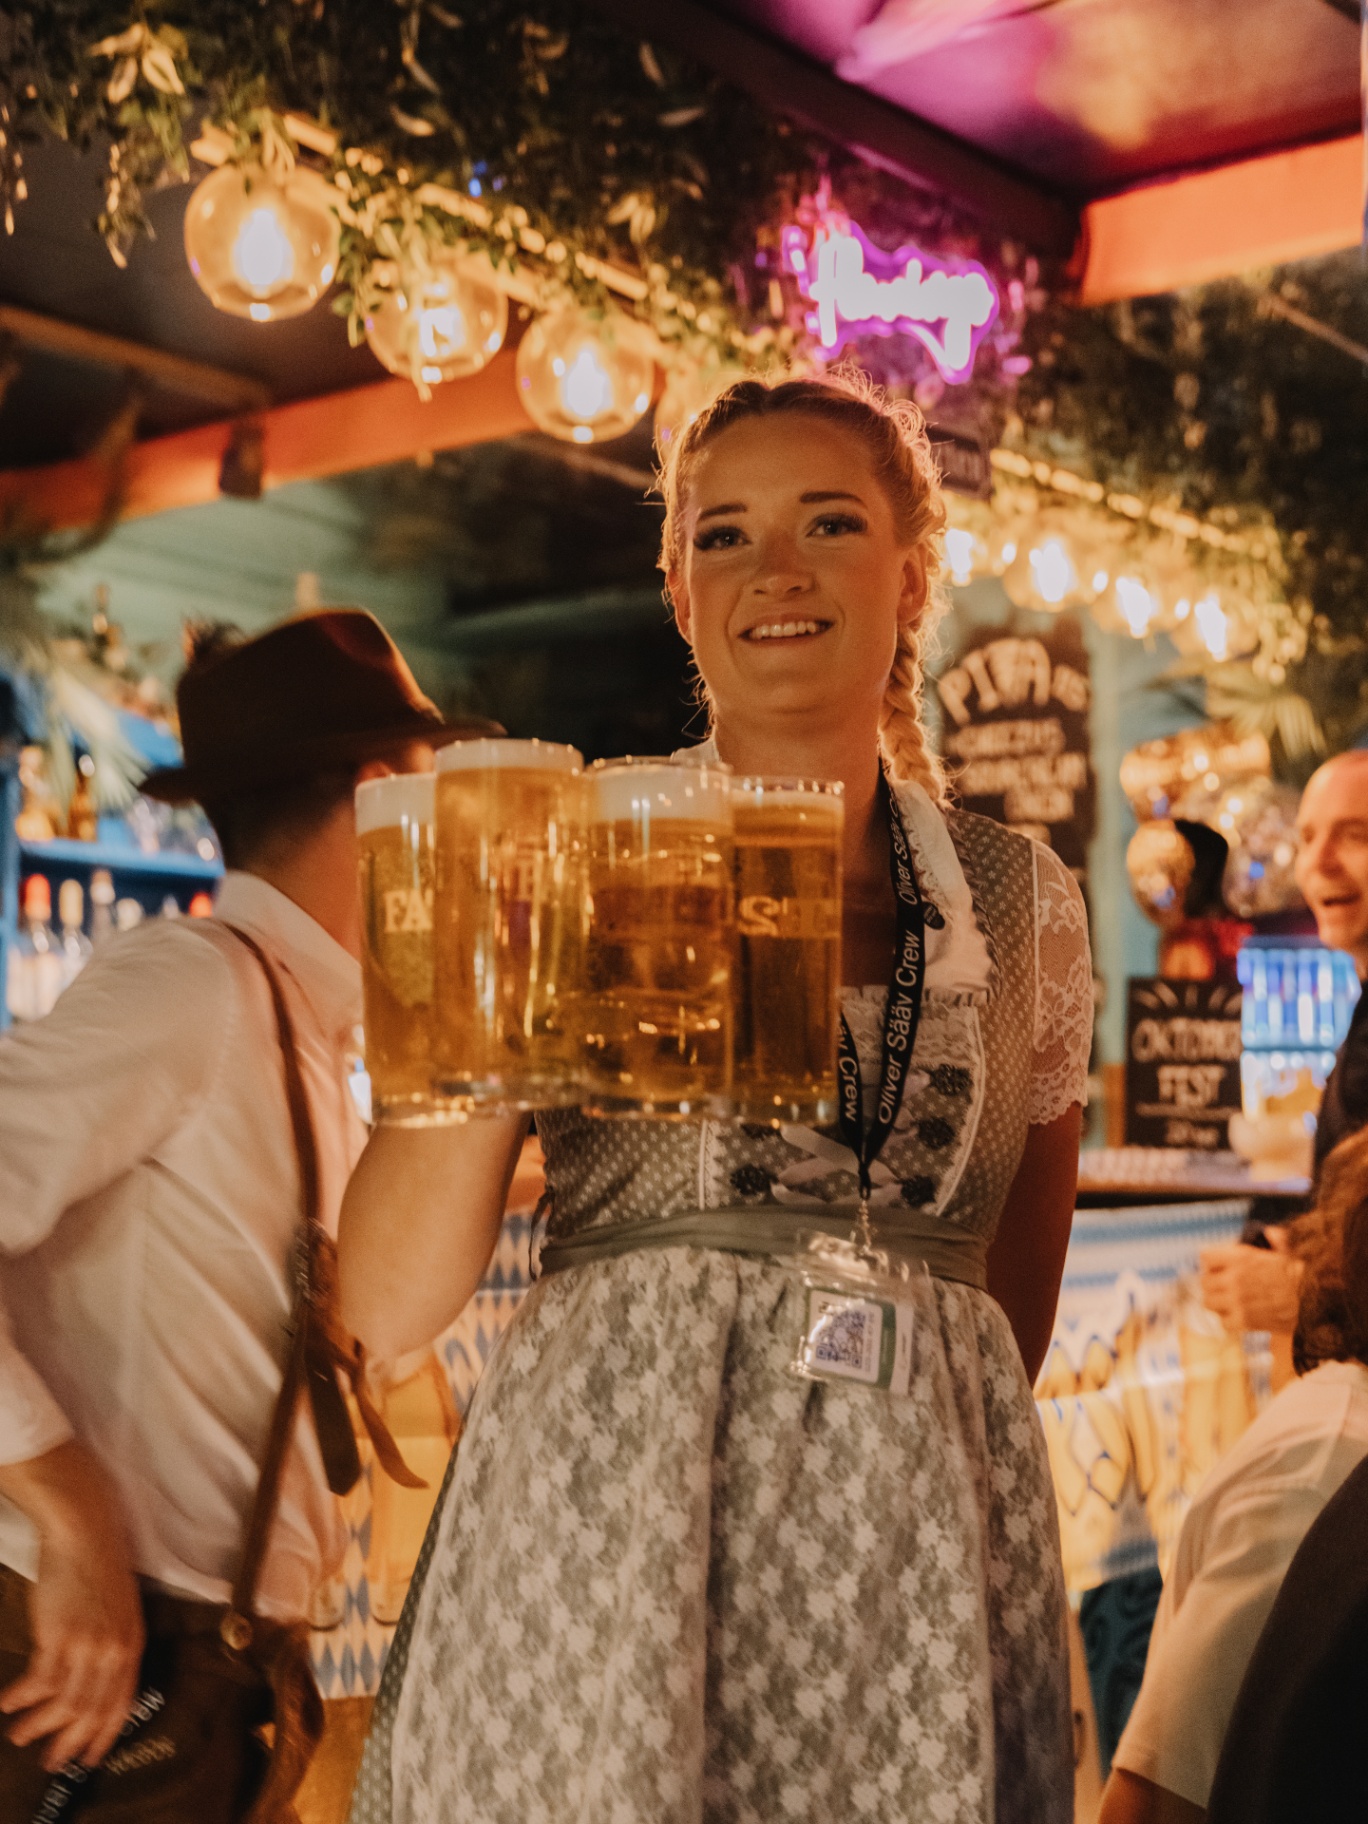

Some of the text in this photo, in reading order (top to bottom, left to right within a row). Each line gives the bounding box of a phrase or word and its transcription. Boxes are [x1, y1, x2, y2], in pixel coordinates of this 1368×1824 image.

[896, 860, 918, 905] Oliver
[878, 930, 920, 1125] Oliver Sääv Crew
[838, 1056, 859, 1122] Crew
[1156, 1065, 1228, 1108] FEST
